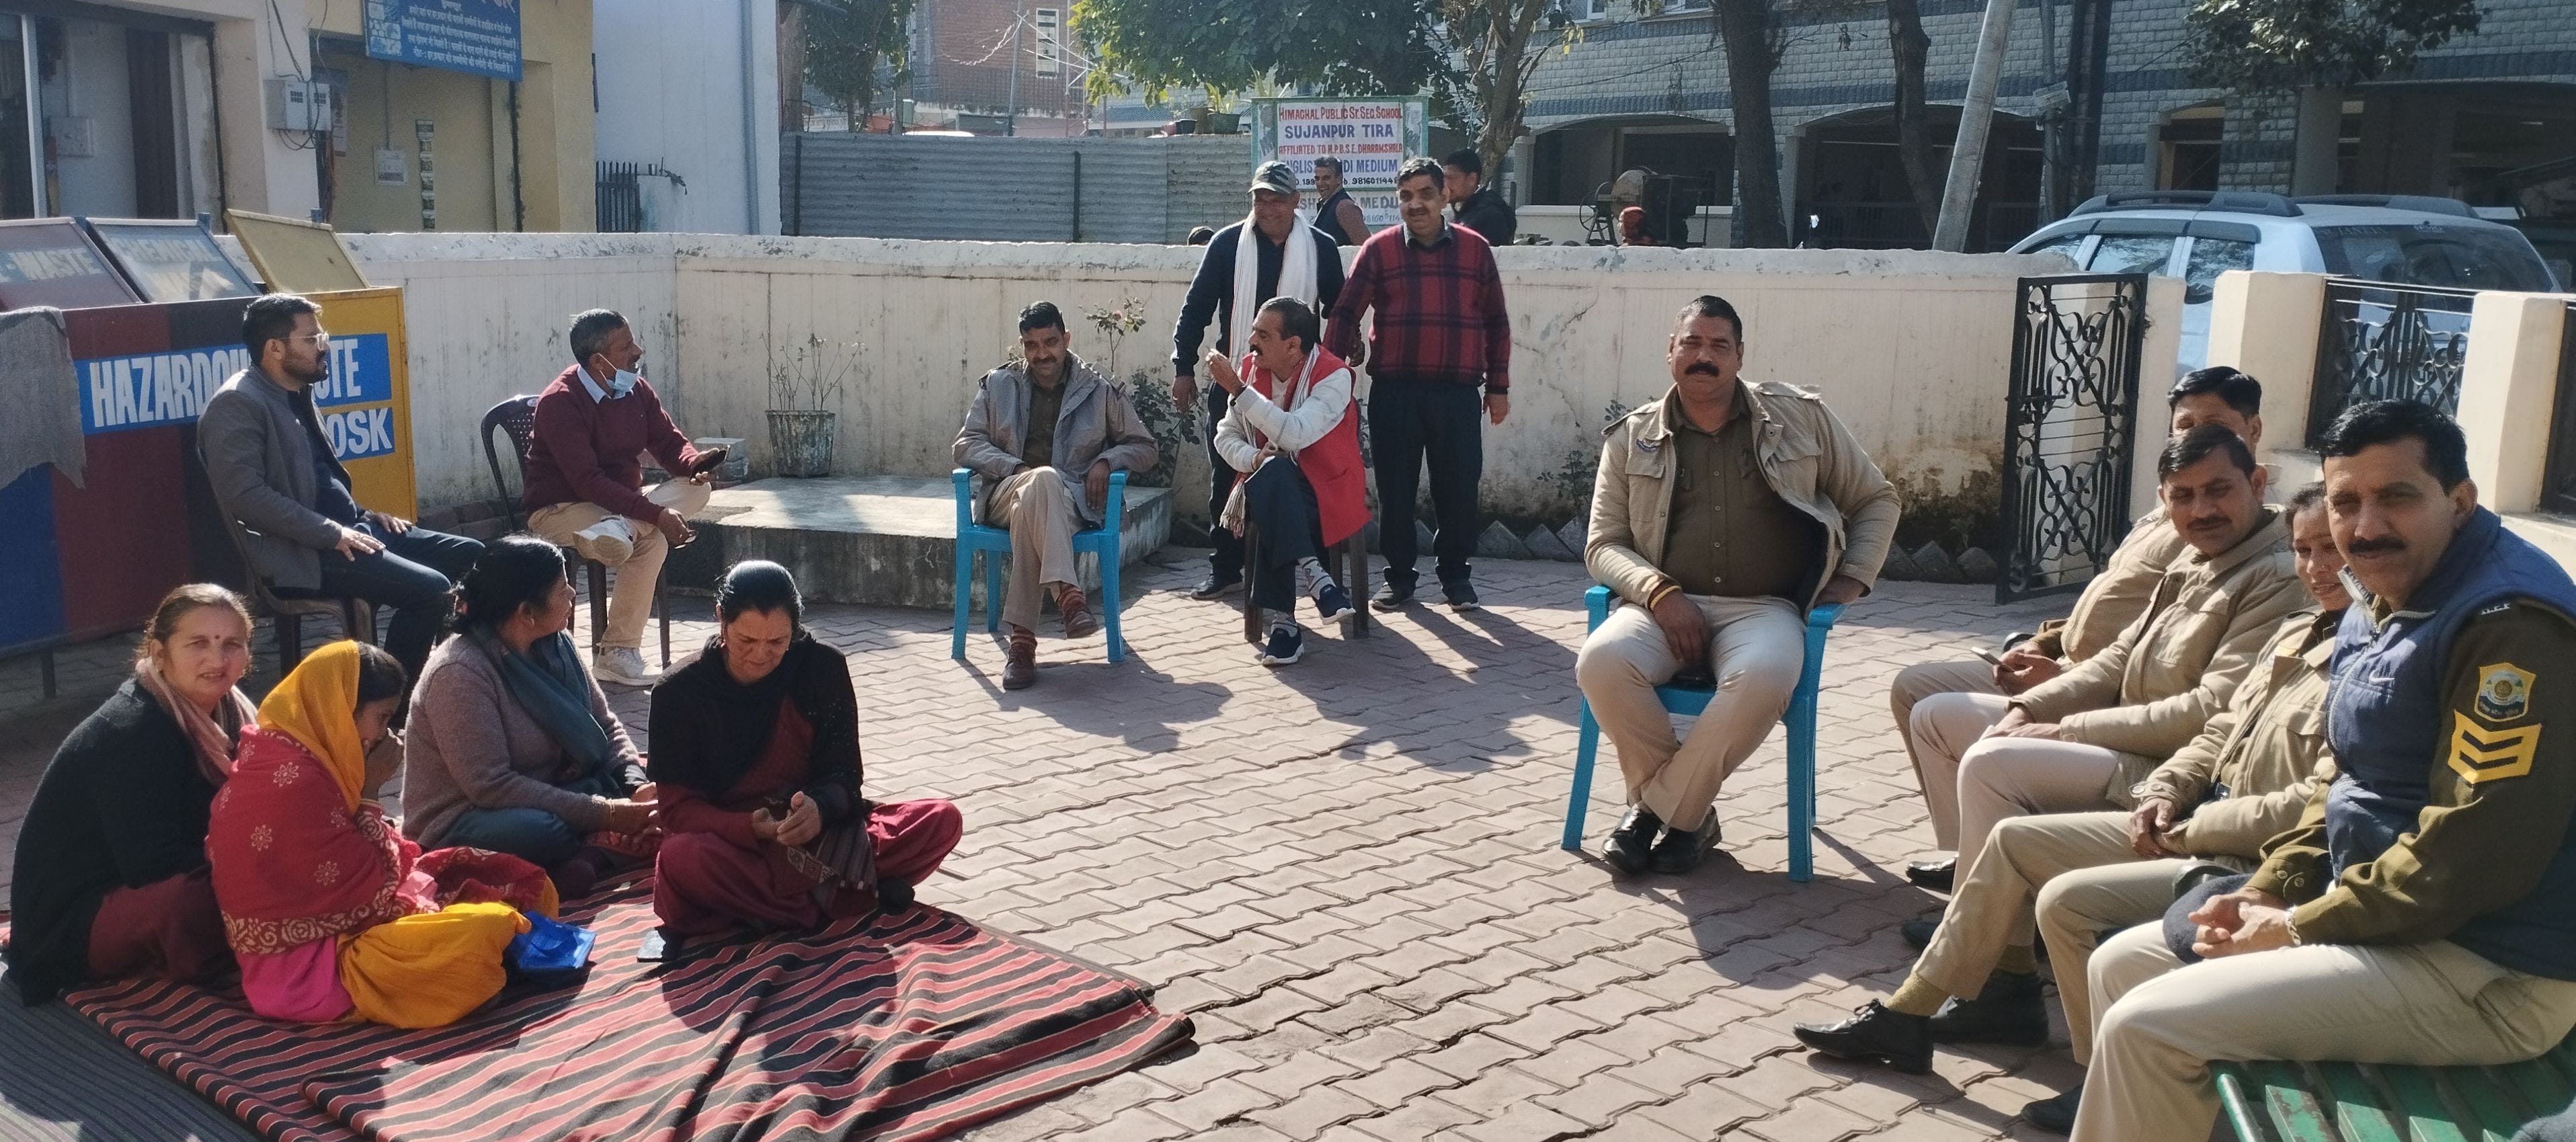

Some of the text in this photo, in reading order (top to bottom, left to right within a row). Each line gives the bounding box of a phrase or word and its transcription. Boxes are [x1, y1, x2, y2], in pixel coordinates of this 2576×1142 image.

[1279, 108, 1320, 122] HIMACHAL
[1321, 106, 1348, 120] PUBLIC
[1285, 124, 1394, 139] SUJANPUR TIRA
[1318, 145, 1326, 155] TO
[1282, 160, 1316, 173] NGLIS
[1357, 159, 1398, 173] MEDIUM
[89, 348, 251, 428] HAZARDO
[326, 407, 393, 458] OSK
